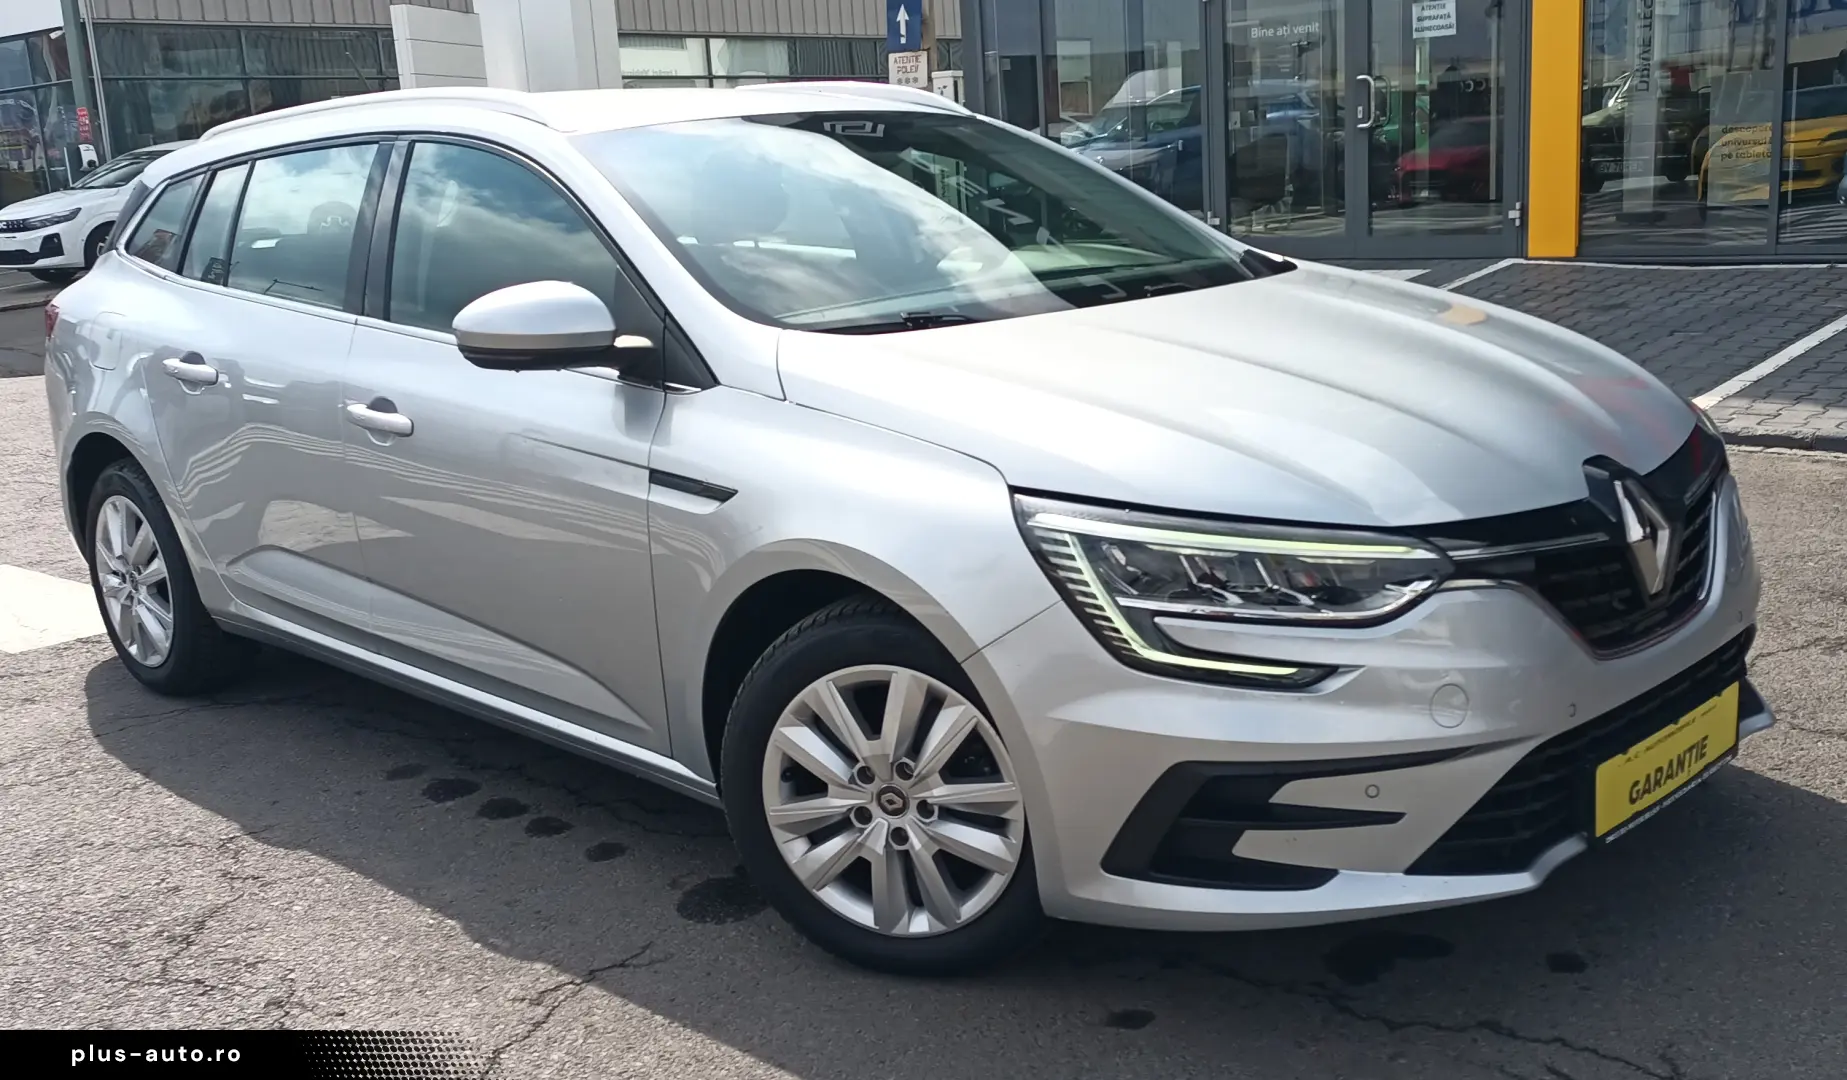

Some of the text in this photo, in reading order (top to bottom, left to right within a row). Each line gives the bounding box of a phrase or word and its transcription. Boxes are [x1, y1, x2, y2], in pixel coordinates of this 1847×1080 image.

[1251, 27, 1274, 38] Bine
[1292, 22, 1319, 33] venit
[1721, 152, 1734, 161] pe
